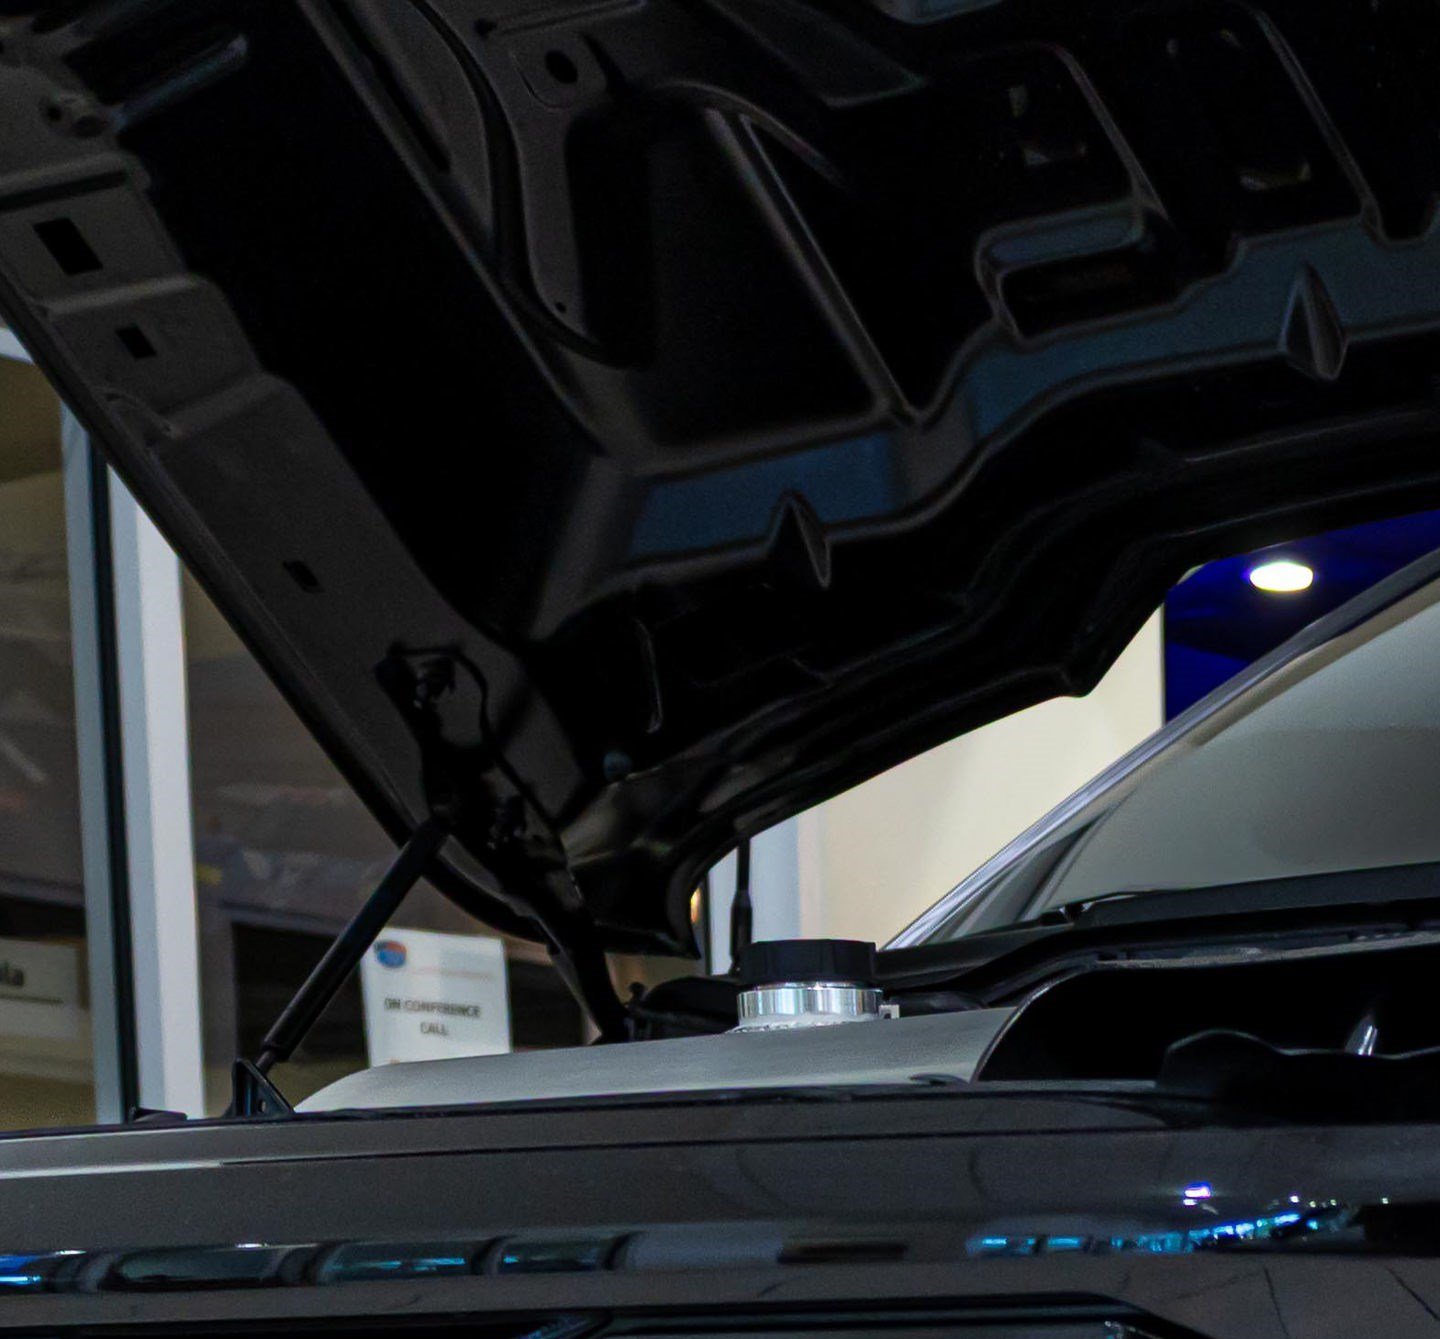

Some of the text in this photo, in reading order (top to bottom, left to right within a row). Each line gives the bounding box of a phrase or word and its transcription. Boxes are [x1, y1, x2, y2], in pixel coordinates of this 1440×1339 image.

[384, 997, 480, 1018] ON CONFERENCE
[420, 1022, 448, 1036] CALL
